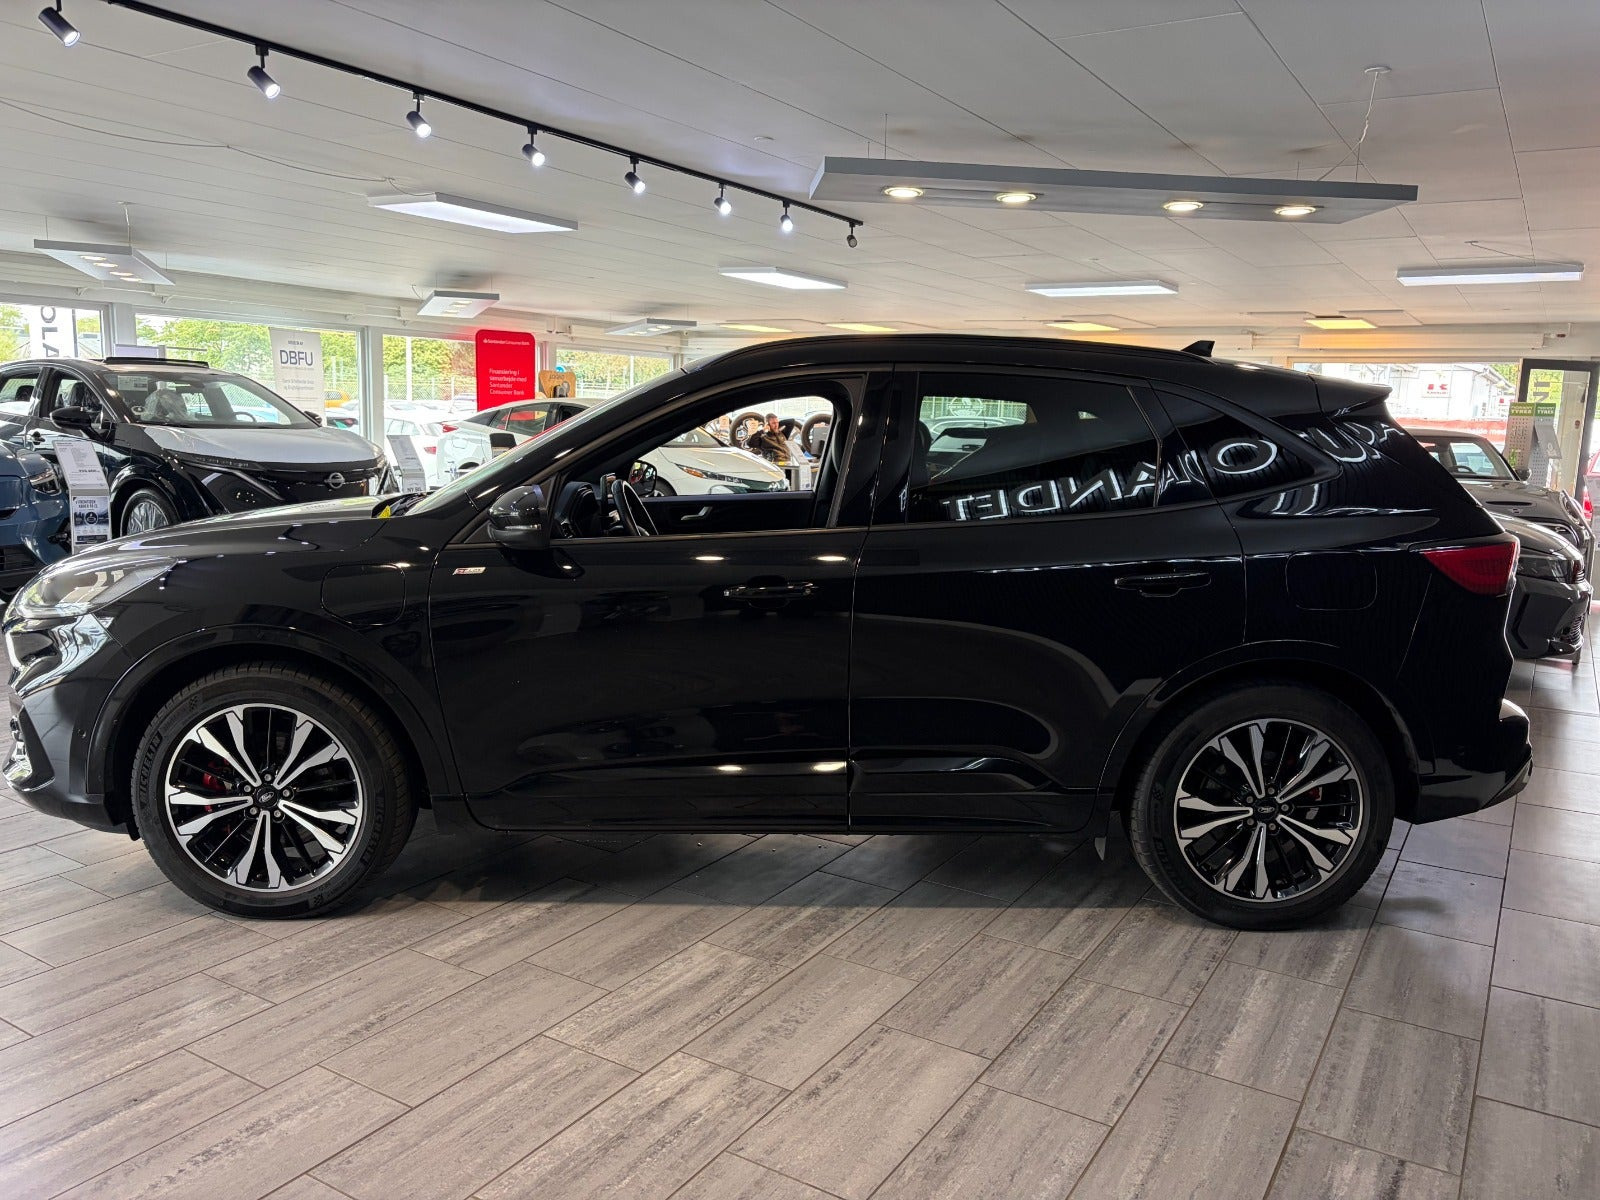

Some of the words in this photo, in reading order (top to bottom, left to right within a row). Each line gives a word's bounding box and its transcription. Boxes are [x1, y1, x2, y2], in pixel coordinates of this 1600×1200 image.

[280, 350, 313, 366] DBFU
[489, 368, 517, 376] Finansiering
[140, 731, 162, 802] MICHELIN
